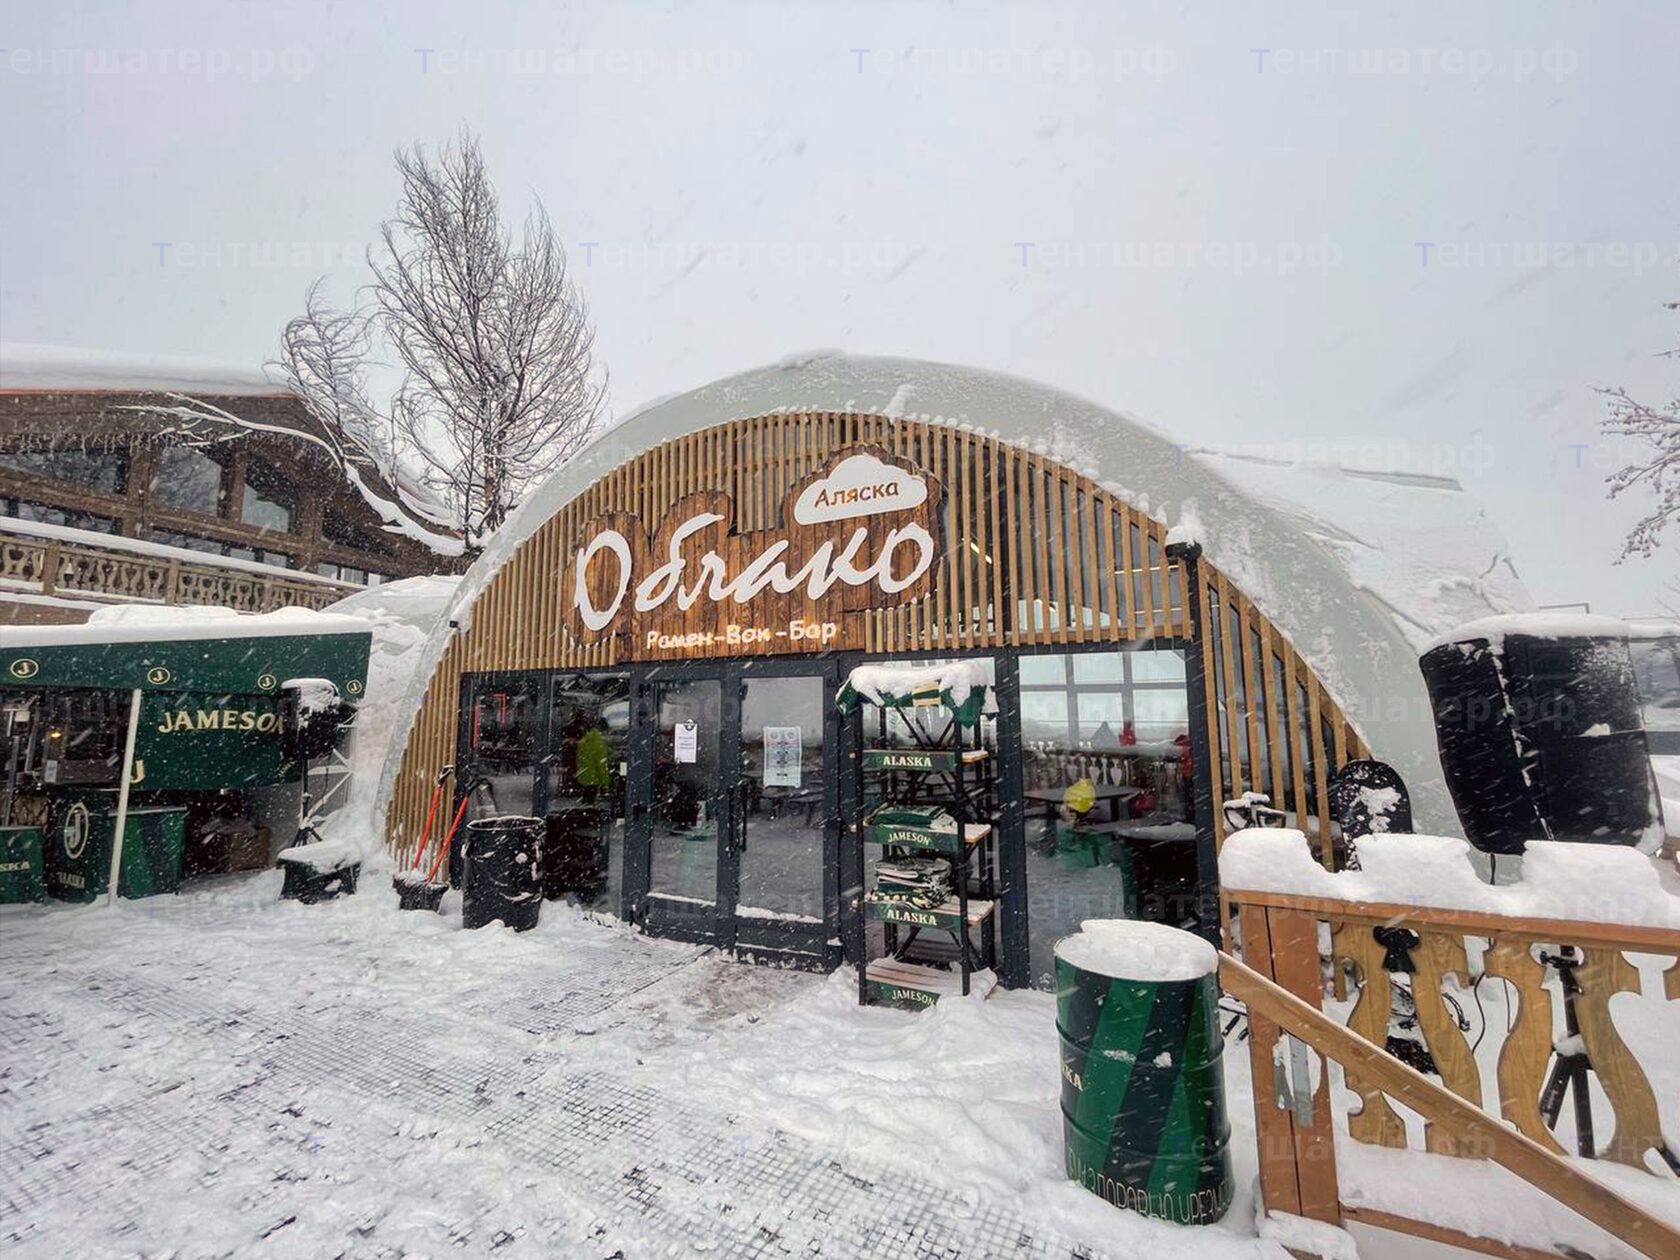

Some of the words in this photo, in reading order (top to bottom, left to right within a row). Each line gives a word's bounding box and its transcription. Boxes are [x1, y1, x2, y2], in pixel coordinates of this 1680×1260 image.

[814, 479, 900, 508] Аляска
[574, 512, 934, 631] Облако
[883, 755, 933, 768] ALASKA
[888, 831, 931, 846] JAMESON
[887, 909, 938, 926] ALASKA
